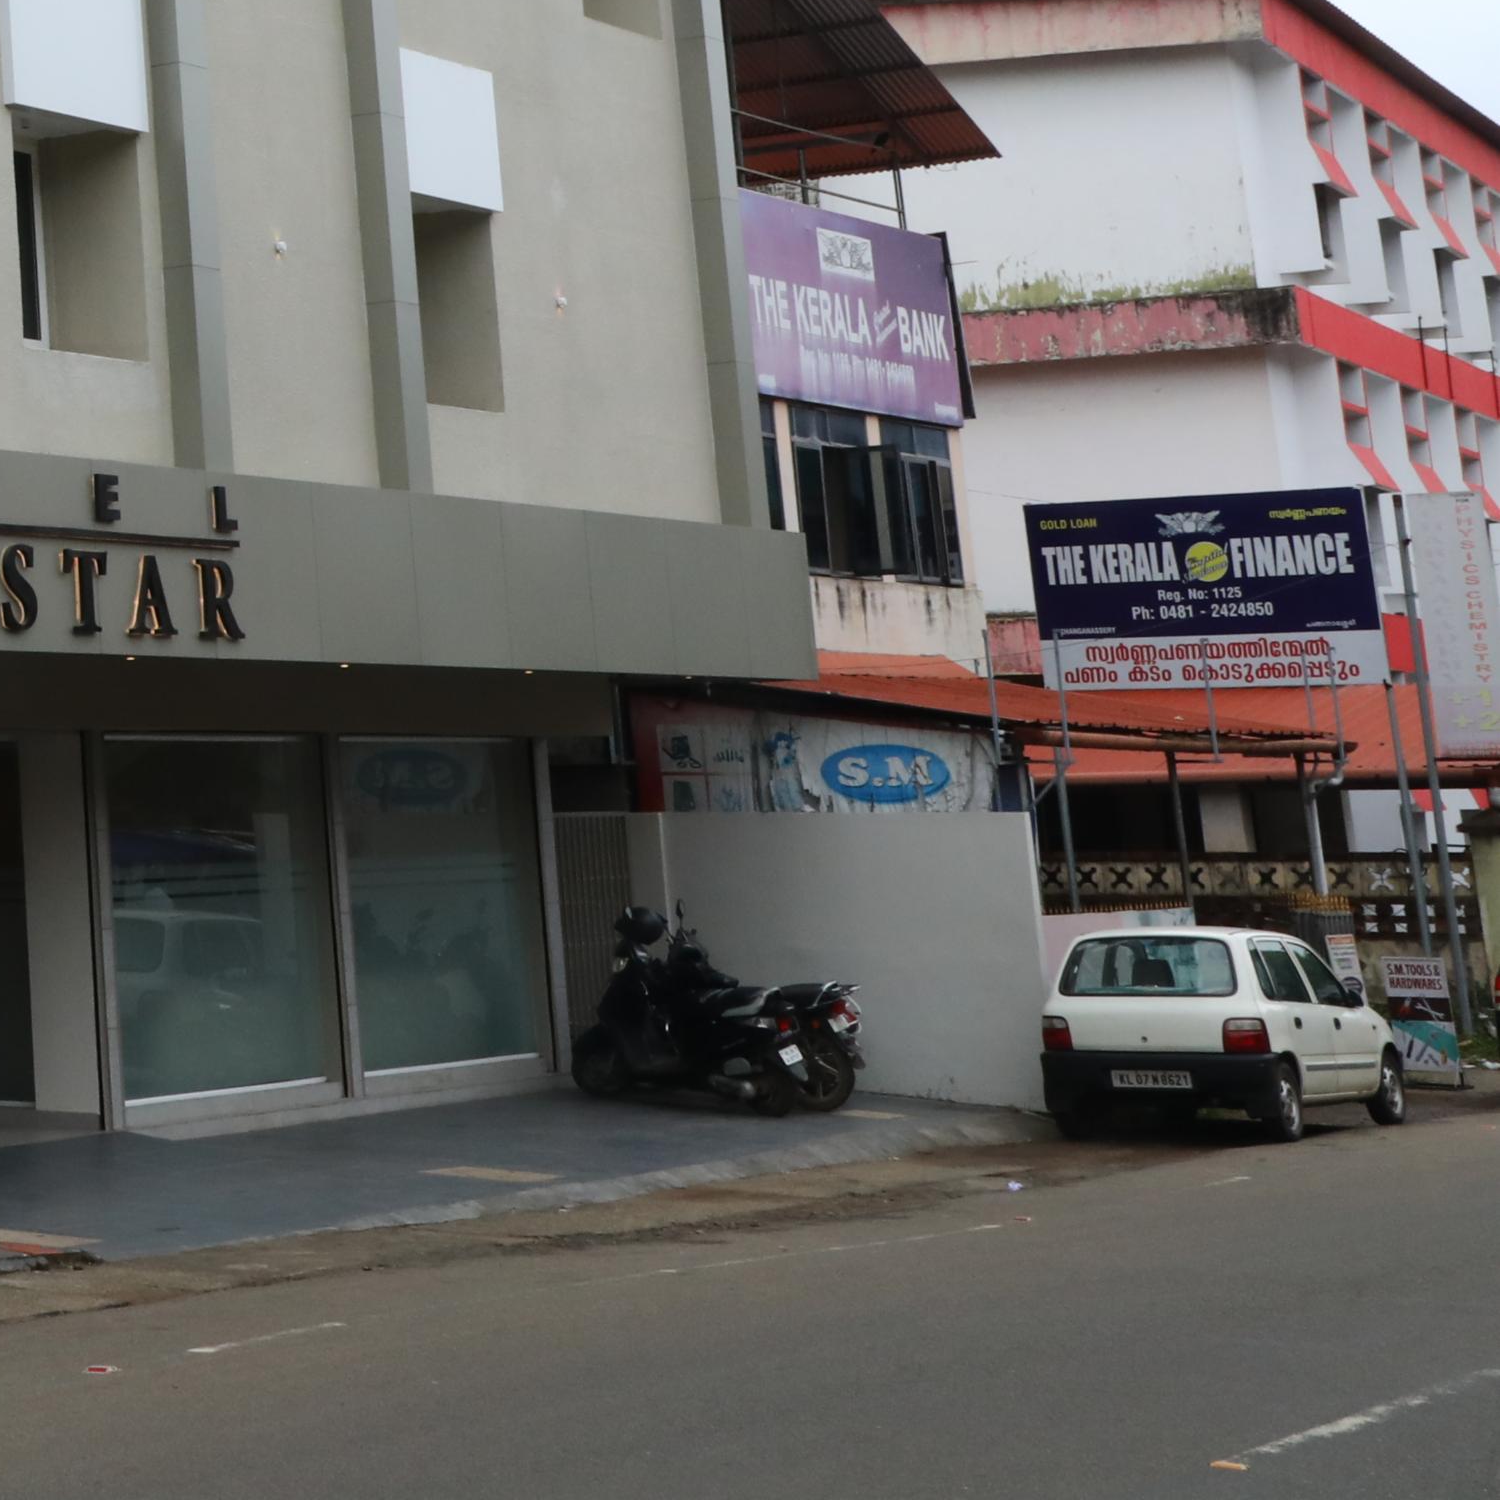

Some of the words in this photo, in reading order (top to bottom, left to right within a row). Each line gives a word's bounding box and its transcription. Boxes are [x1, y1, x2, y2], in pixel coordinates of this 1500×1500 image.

[748, 274, 791, 330] THE
[792, 284, 873, 346] KERALA
[896, 306, 950, 361] BANK
[1040, 519, 1067, 530] GOLD
[1070, 518, 1097, 529] LOAN
[1041, 545, 1088, 586] THE
[1088, 541, 1181, 584] KERALA
[1229, 532, 1355, 578] FINANCE
[1157, 589, 1185, 603] Reg.
[1188, 589, 1209, 600] No:
[1212, 586, 1243, 599] 1125
[1132, 607, 1155, 621] Ph:
[1159, 605, 1193, 620] 0481
[1210, 602, 1274, 618] 2424850
[1064, 667, 1119, 684] പണം
[1128, 665, 1172, 683] കടം
[1388, 978, 1443, 990] HARDWARES
